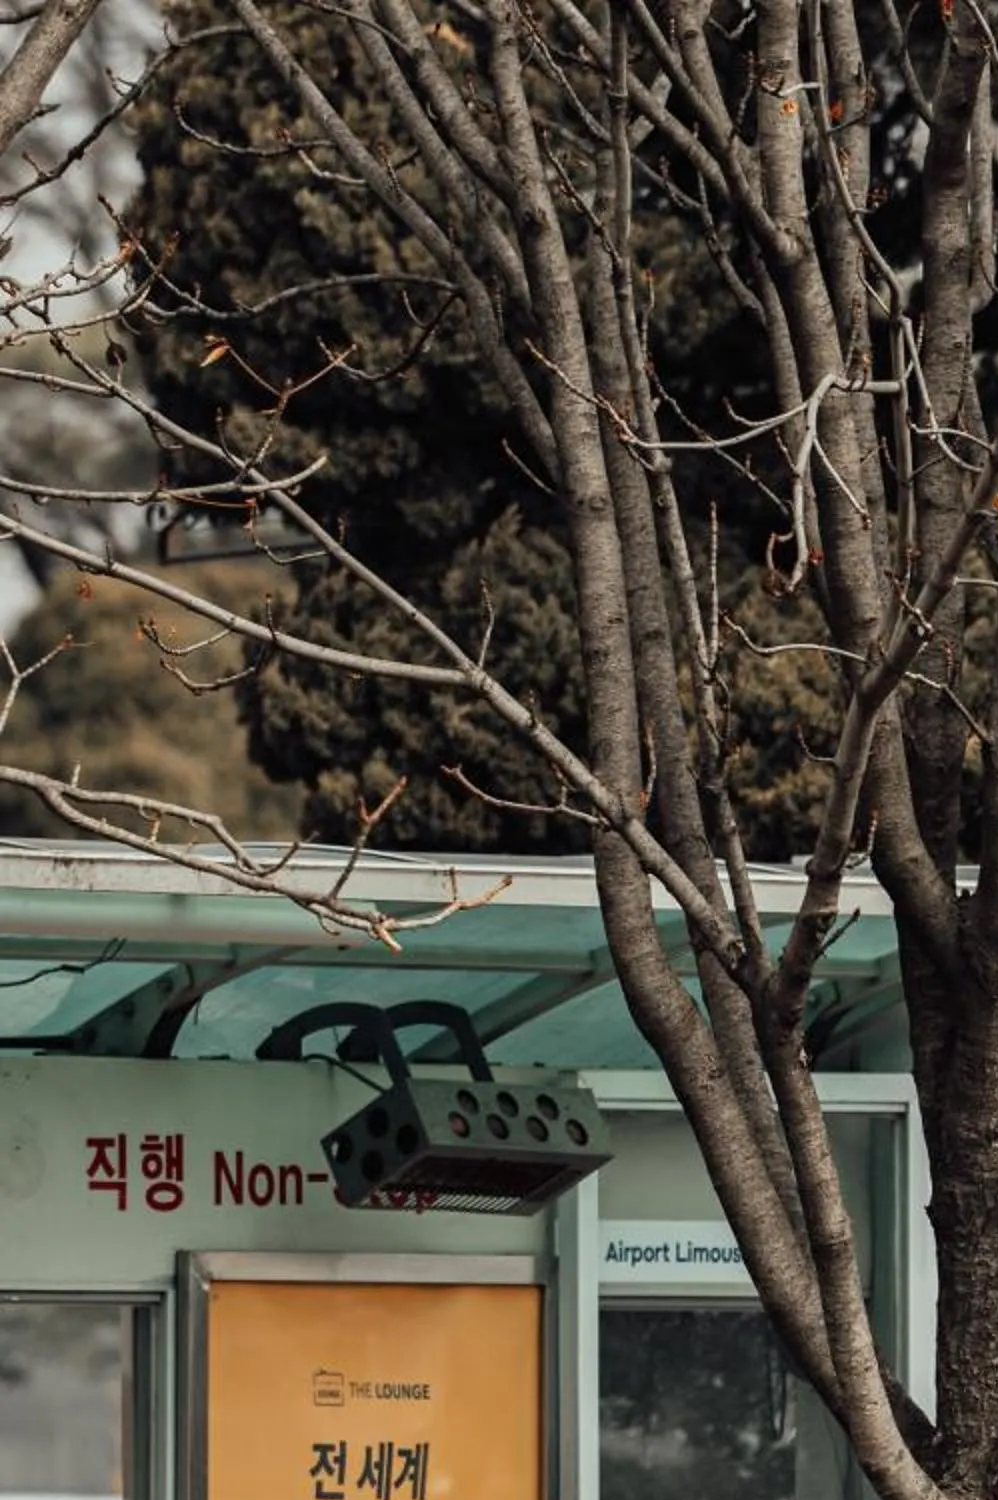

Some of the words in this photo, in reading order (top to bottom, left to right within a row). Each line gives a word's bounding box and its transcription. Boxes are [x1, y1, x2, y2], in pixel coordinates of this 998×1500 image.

[86, 1132, 184, 1212] 직행
[605, 1241, 670, 1267] Airport
[675, 1241, 741, 1263] Limous
[350, 1382, 373, 1398] THE
[375, 1384, 431, 1400] LOUNGE
[309, 1440, 347, 1500] 전
